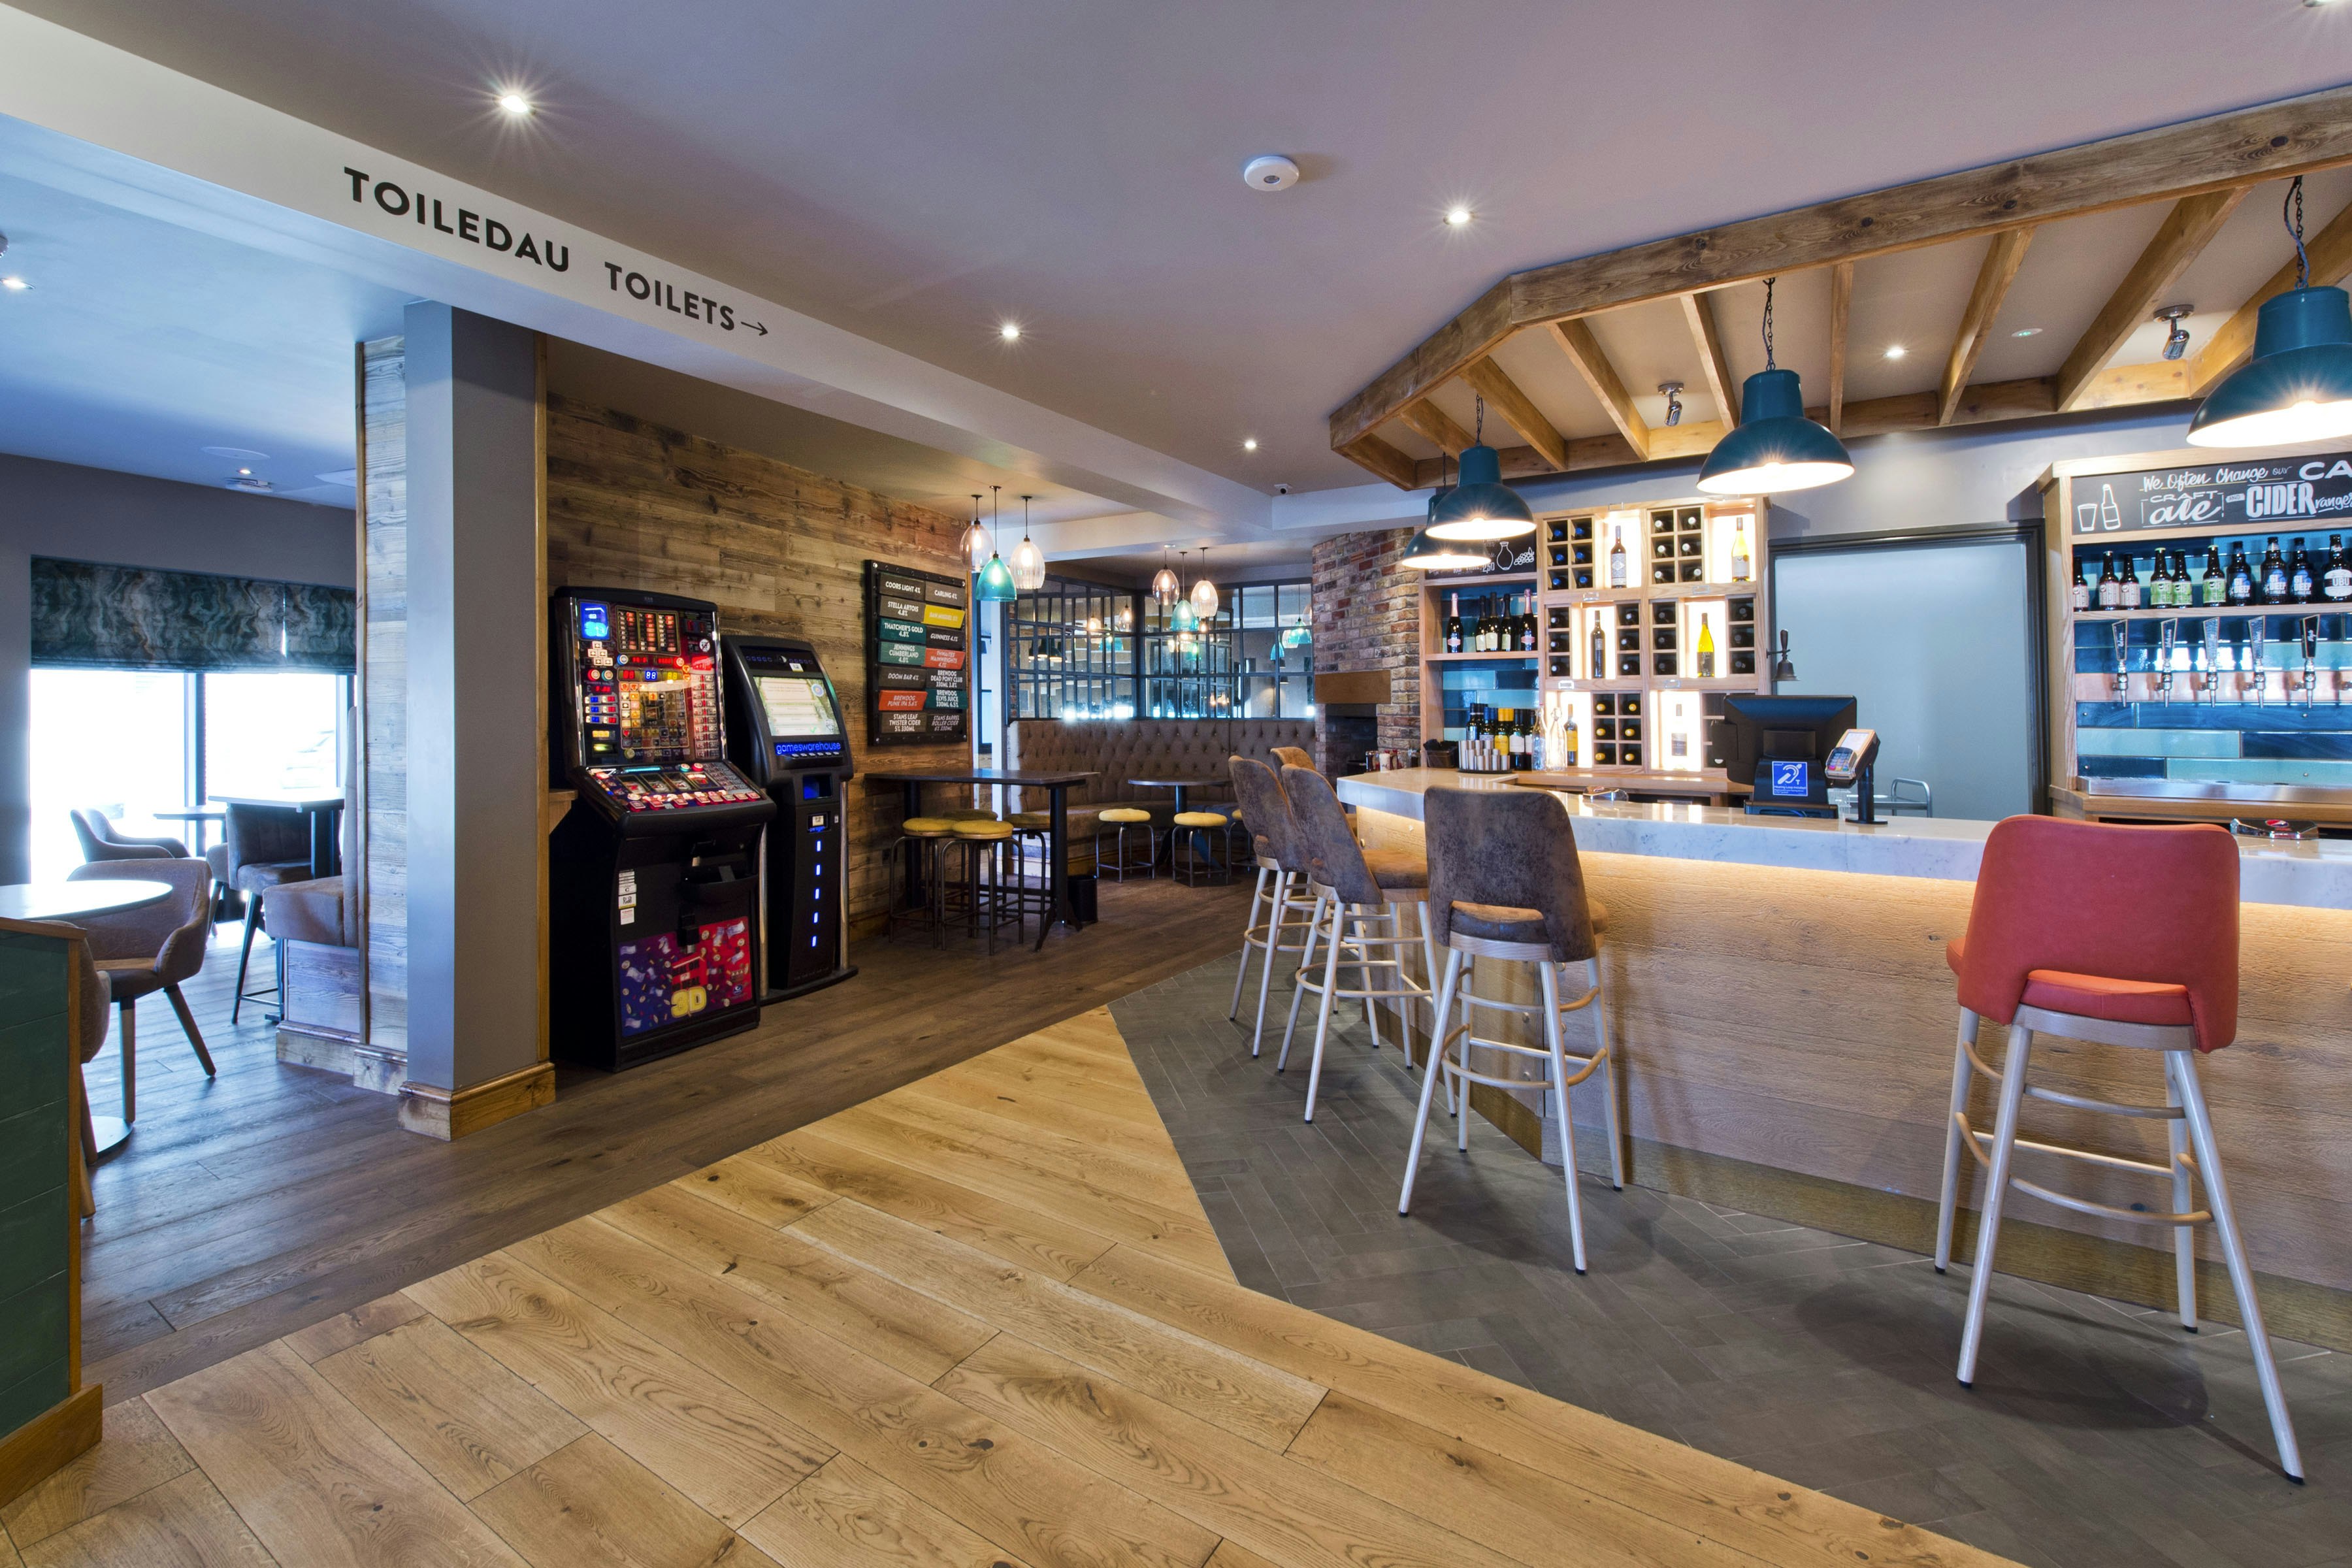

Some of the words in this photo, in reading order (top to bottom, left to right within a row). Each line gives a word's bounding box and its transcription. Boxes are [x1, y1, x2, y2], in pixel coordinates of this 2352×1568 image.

[344, 167, 569, 272] TOILEDAU
[604, 261, 734, 331] TOILETS
[2143, 476, 2163, 492] We
[2167, 471, 2211, 491] Often
[2215, 466, 2268, 483] Change
[2150, 490, 2219, 503] CRAFT
[2149, 498, 2221, 525] ale
[2246, 482, 2317, 518] CIDER
[885, 581, 902, 590] COORS
[902, 584, 915, 593] LIGHT
[2332, 578, 2350, 586] UBU
[934, 589, 952, 598] CARLING
[888, 601, 903, 610] STELLA
[884, 623, 911, 632] THATCHER'S
[776, 741, 841, 755] gameswarehouse
[671, 985, 707, 1018] 3D
